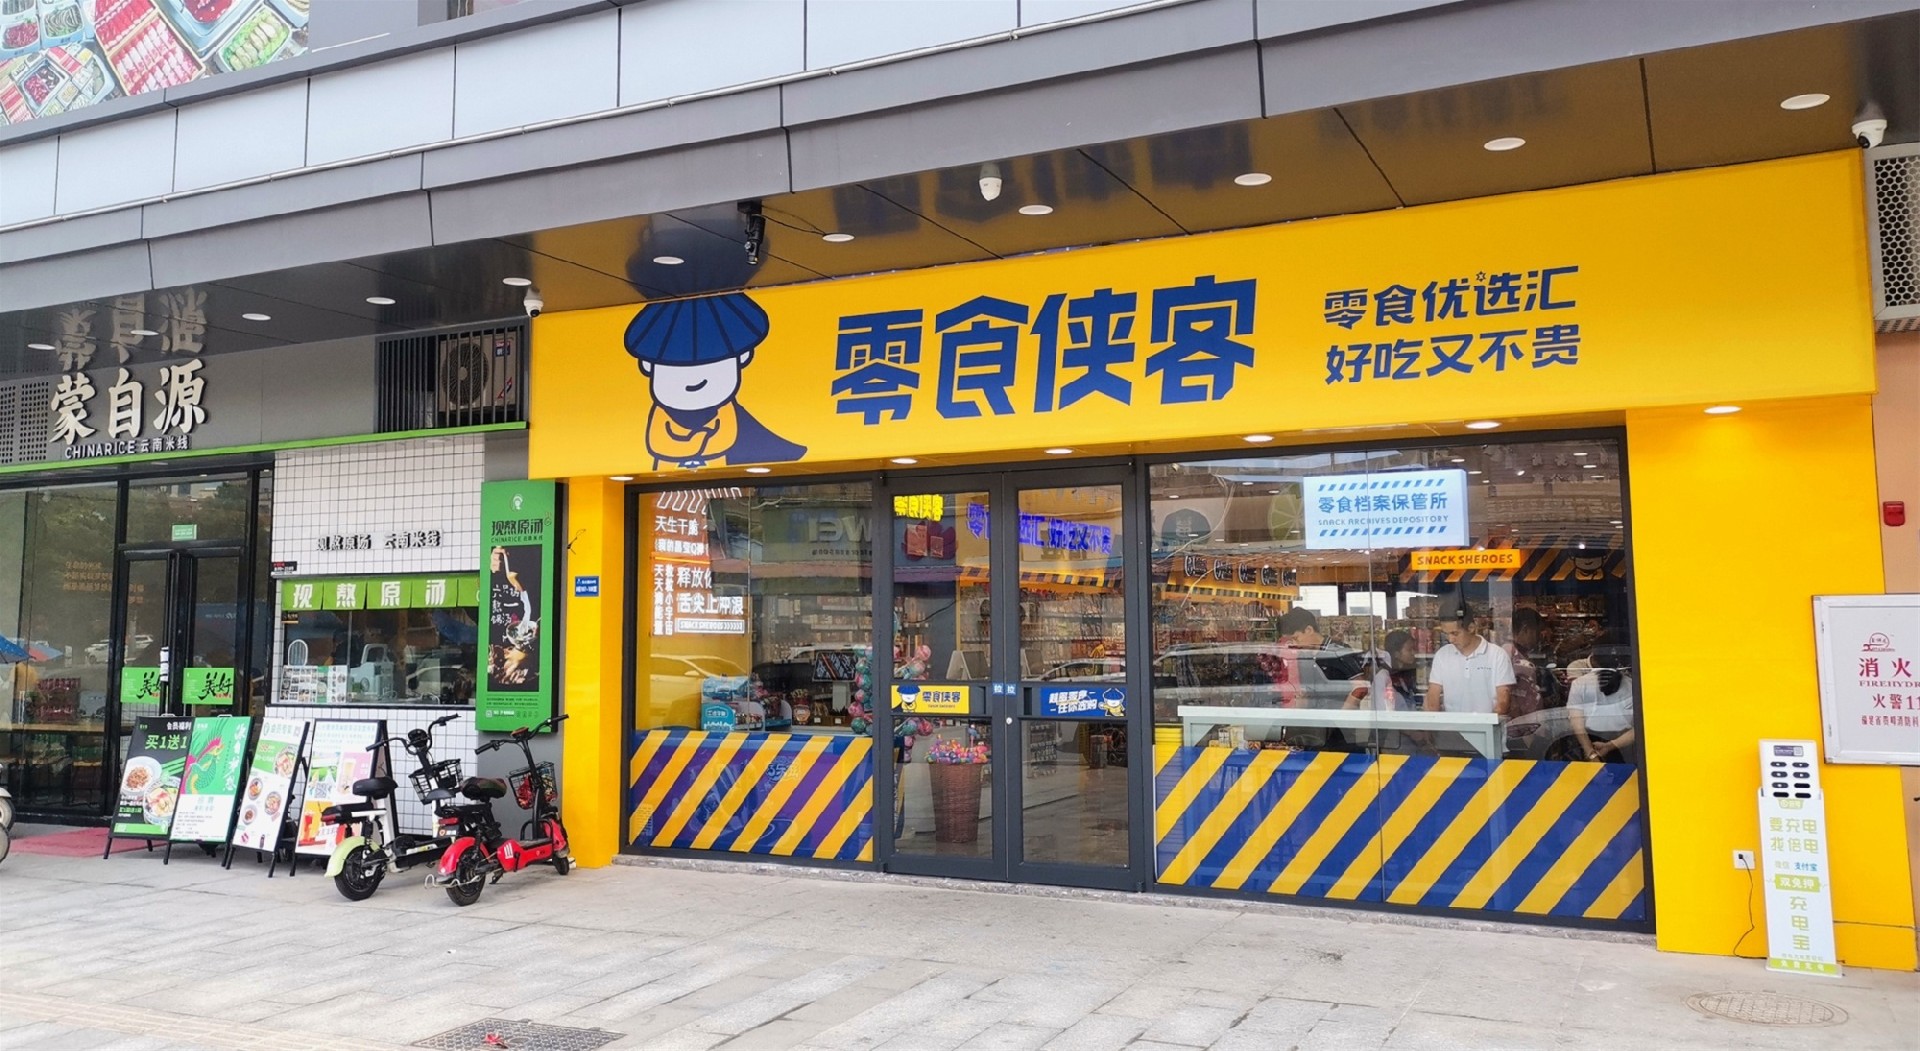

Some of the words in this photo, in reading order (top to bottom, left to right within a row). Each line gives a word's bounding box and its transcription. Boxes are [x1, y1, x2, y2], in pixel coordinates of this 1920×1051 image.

[1323, 265, 1579, 330] 零食优选汇
[829, 275, 1258, 426] 零食侠客
[1325, 324, 1581, 385] 好吃又不贵
[50, 358, 207, 446] 蒙自源
[65, 440, 136, 459] CHINARICE
[140, 435, 189, 453] 云南米线
[1318, 491, 1448, 514] 零食档案保管所
[491, 518, 544, 536] 现熬原汤
[1318, 518, 1346, 526] SNACK
[1348, 516, 1391, 526] ARCHIVES
[1393, 515, 1449, 525] DEPOSITORY
[1417, 555, 1456, 566] SNACK
[1458, 553, 1513, 565] SHEROES
[292, 578, 447, 609] 现熬原汤
[1859, 657, 1912, 678] 消火
[922, 690, 961, 703] 零食侠客
[145, 734, 188, 750] 买1送1
[1769, 816, 1817, 834] 要充电
[1794, 861, 1818, 872] 支付宝
[1779, 876, 1815, 890] 双免押
[1789, 896, 1810, 951] 充电宝
